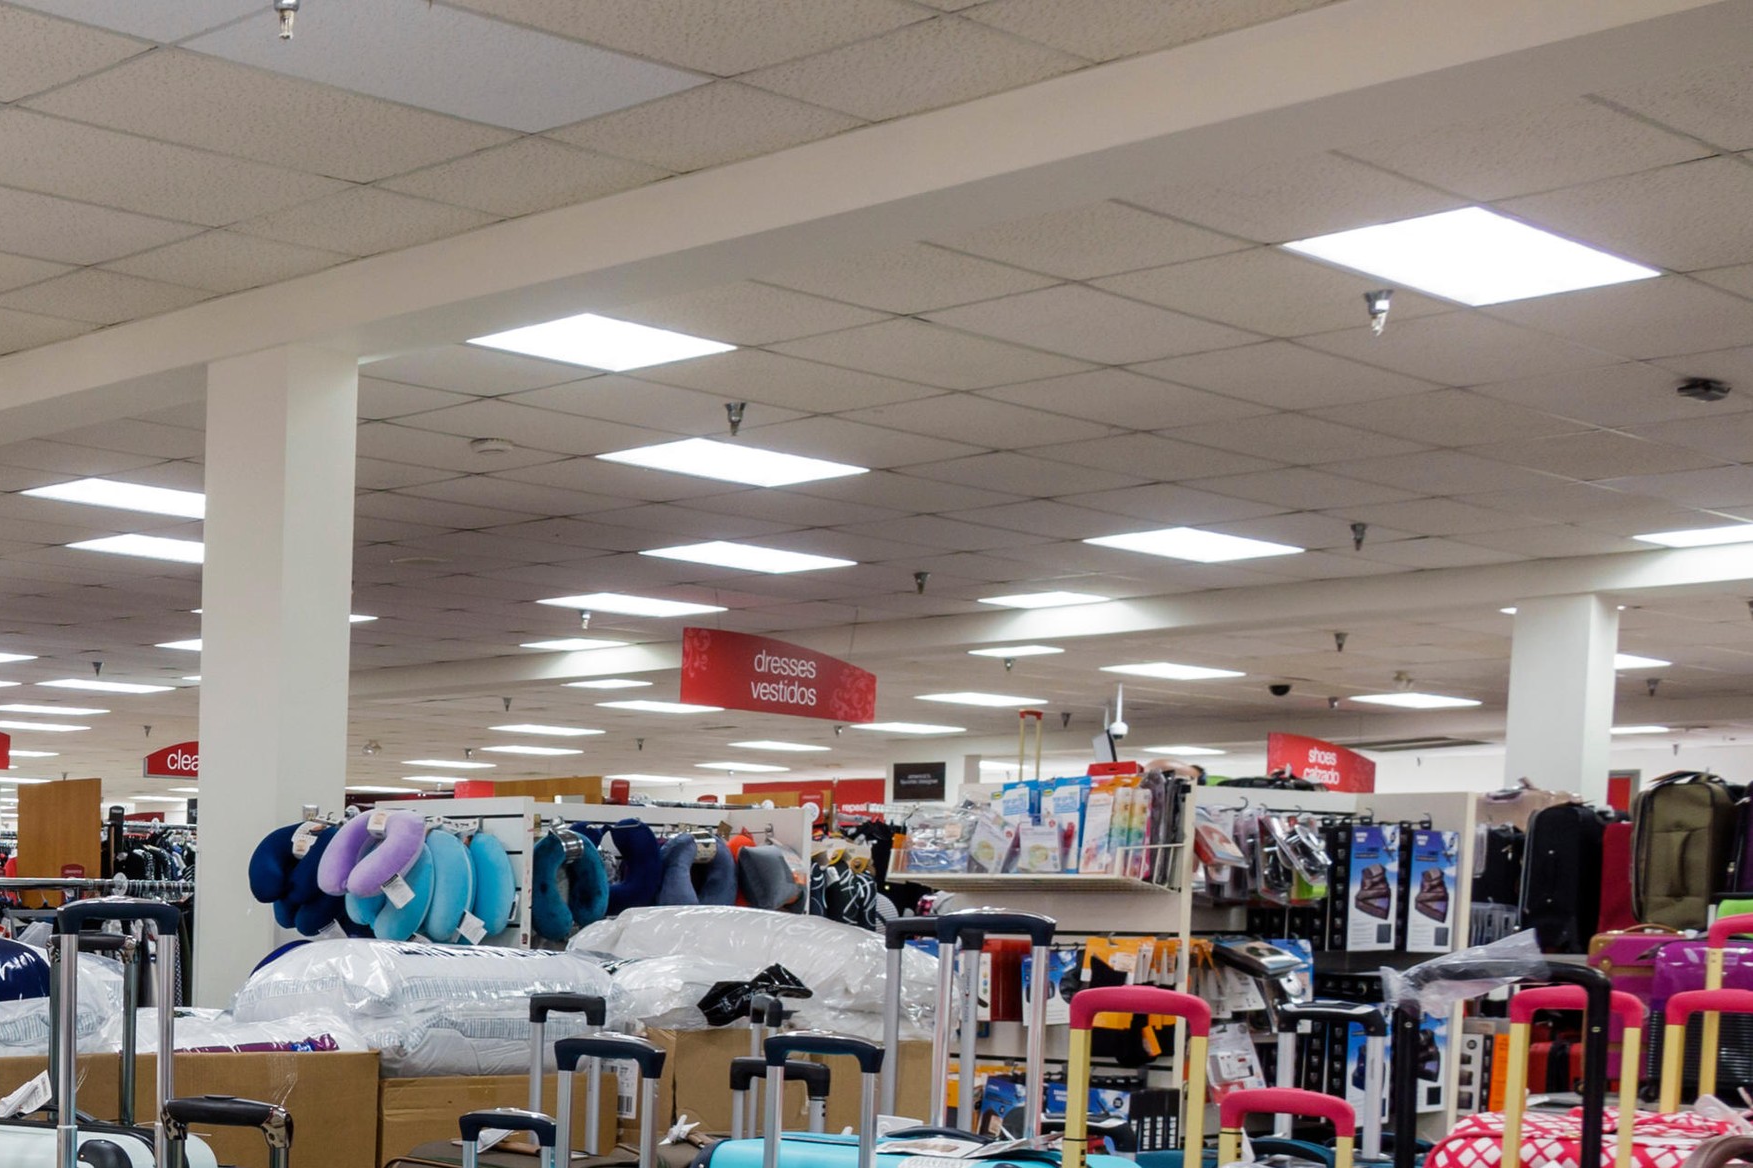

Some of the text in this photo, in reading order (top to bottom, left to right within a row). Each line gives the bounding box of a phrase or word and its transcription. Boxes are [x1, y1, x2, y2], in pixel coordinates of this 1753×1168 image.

[754, 649, 817, 679] dresses
[750, 679, 817, 706] vestidos
[1308, 747, 1337, 766] shoes
[1303, 766, 1340, 785] calzado
